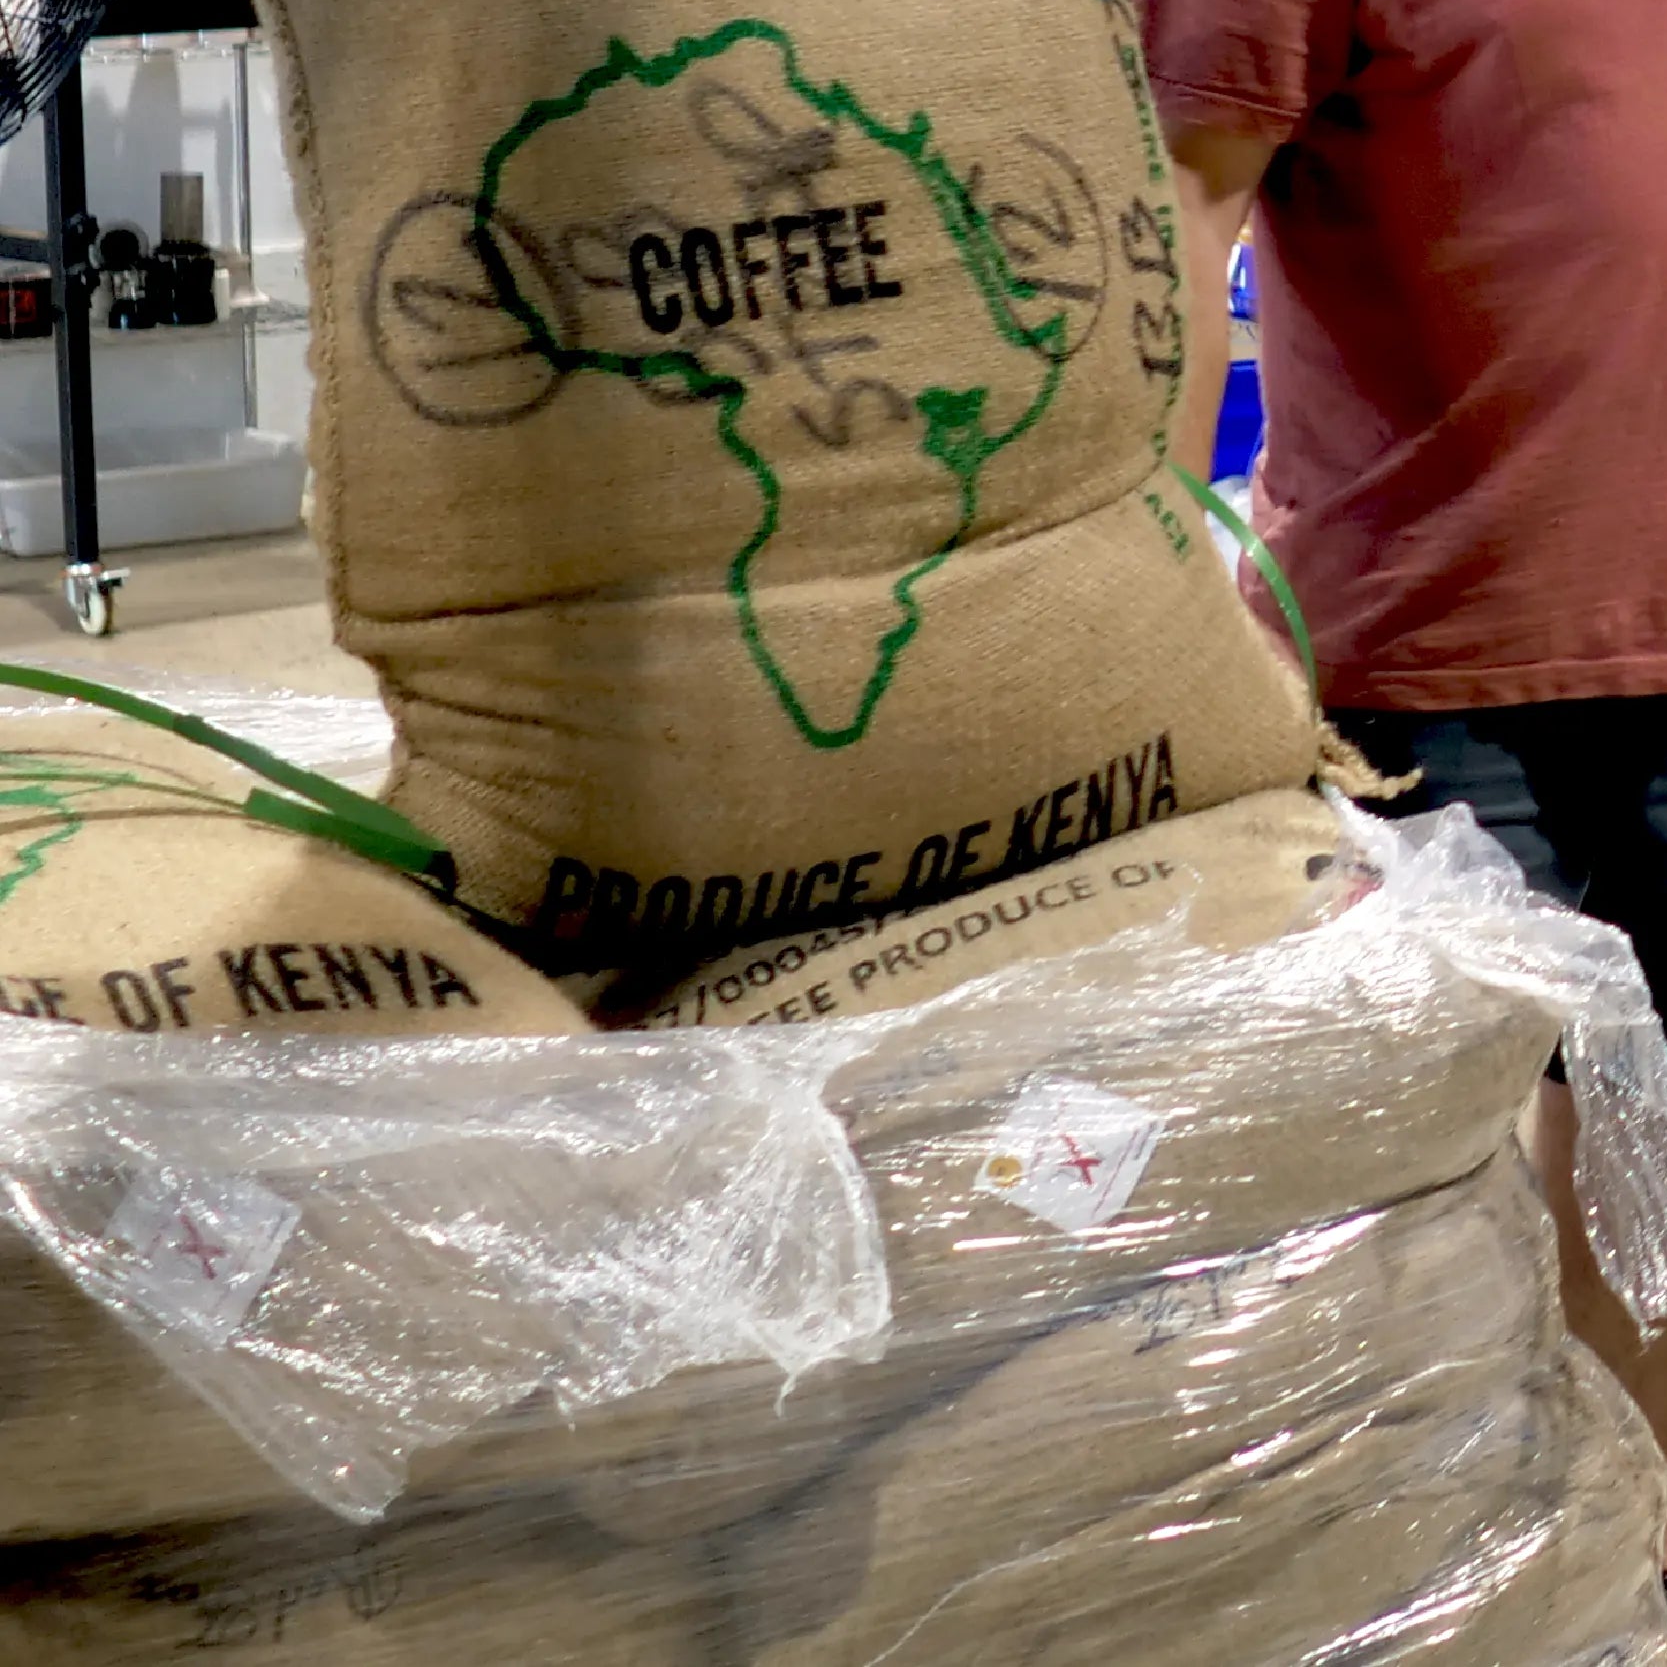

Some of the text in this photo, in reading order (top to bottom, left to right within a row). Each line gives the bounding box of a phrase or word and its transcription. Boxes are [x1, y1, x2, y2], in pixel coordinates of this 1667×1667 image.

[628, 200, 903, 334] COFFEE
[534, 729, 1180, 939] PRODUCE OF KENYA
[100, 955, 197, 1033] OF
[213, 942, 483, 1018] KENYA
[848, 875, 1099, 994] PRODUCE
